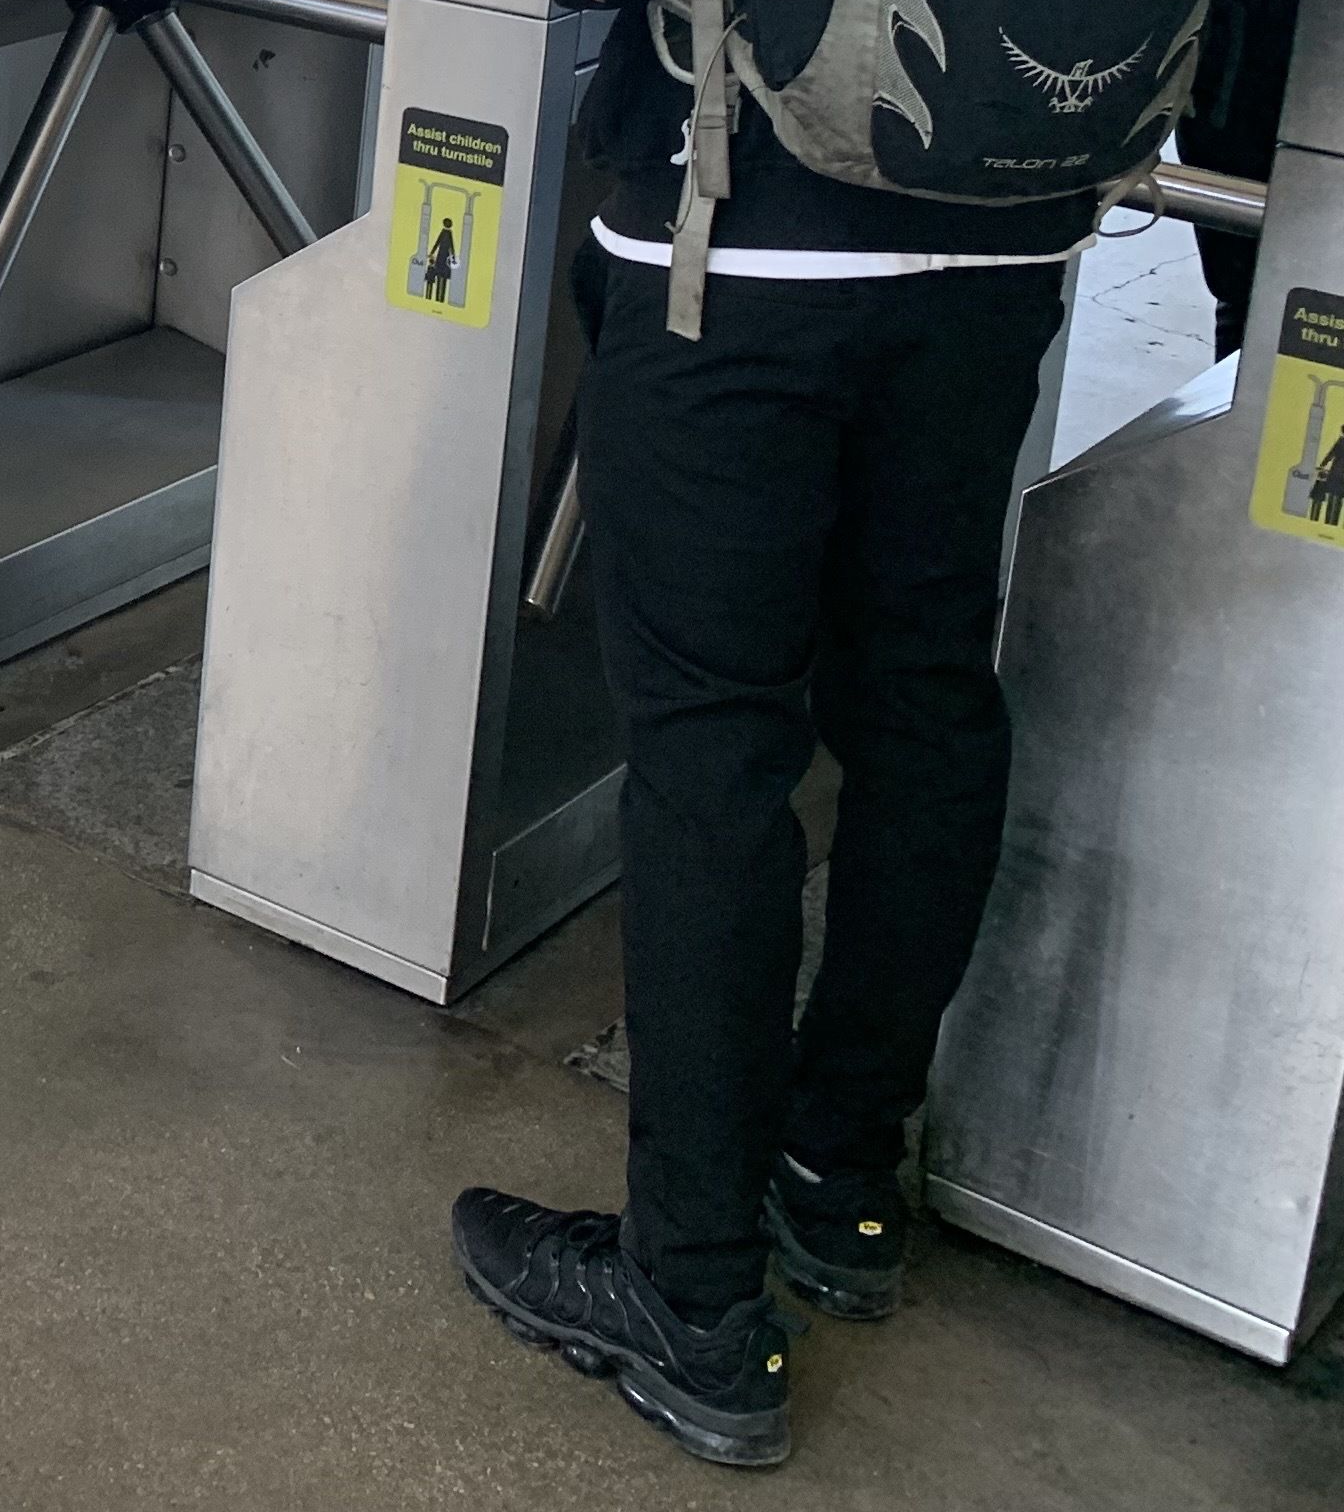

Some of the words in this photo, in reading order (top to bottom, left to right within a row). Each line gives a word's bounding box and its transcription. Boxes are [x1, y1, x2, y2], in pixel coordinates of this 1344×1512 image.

[407, 122, 447, 144] Assist
[449, 129, 502, 155] children
[413, 139, 439, 157] thru
[441, 145, 494, 169] turnstile
[1061, 154, 1090, 167] 22
[1293, 306, 1344, 330] Assis
[1301, 325, 1339, 348] thru
